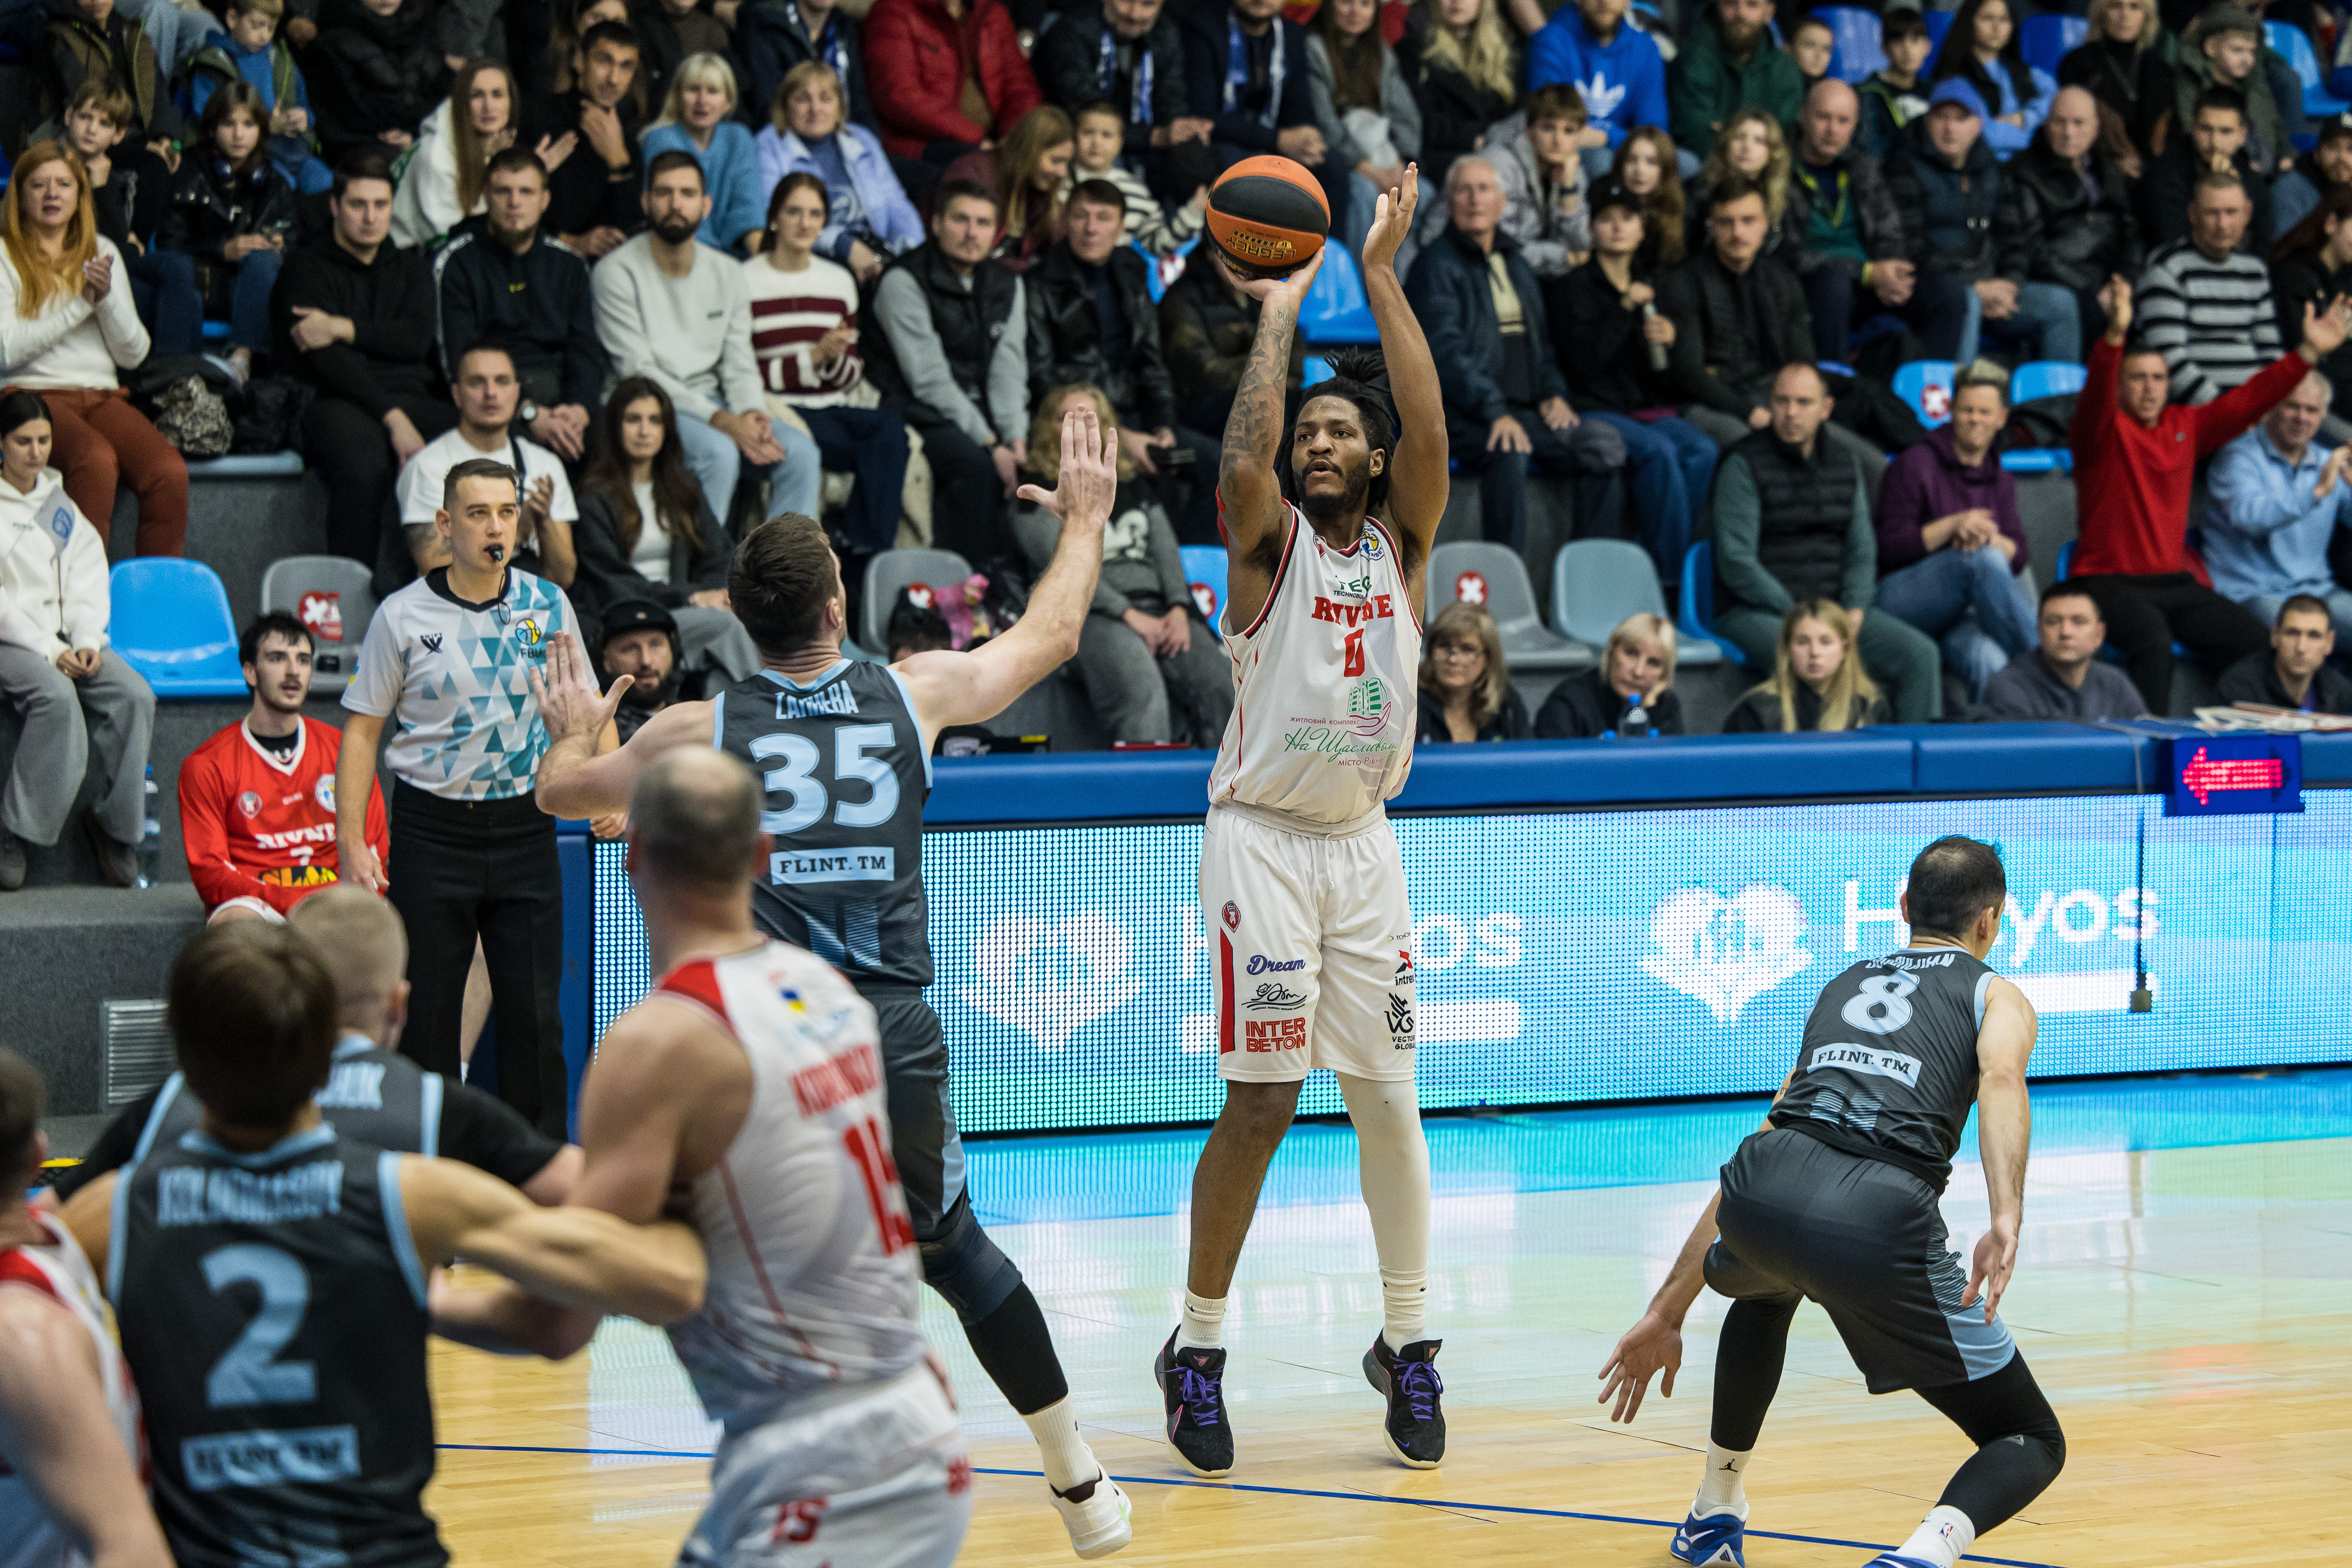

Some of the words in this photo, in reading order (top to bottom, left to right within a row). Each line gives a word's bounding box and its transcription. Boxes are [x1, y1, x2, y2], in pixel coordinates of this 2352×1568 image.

[1226, 236, 1296, 259] LEGACY
[1311, 594, 1394, 628] RIVNE
[1343, 628, 1365, 677] 0
[1285, 726, 1311, 752] На
[1338, 758, 1361, 766] місто
[1364, 756, 1384, 765] Рівне
[748, 722, 901, 835] 35
[780, 857, 853, 874] FLINT.
[858, 856, 886, 869] TM
[1246, 955, 1306, 976] Dream
[1395, 974, 1415, 986] intrex
[1841, 969, 1920, 1035] 8
[1245, 1017, 1306, 1038] INTER
[1246, 1034, 1306, 1053] BETON
[1817, 1050, 1874, 1065] FLINT.
[1882, 1057, 1911, 1074] TM
[199, 1241, 320, 1410] 2
